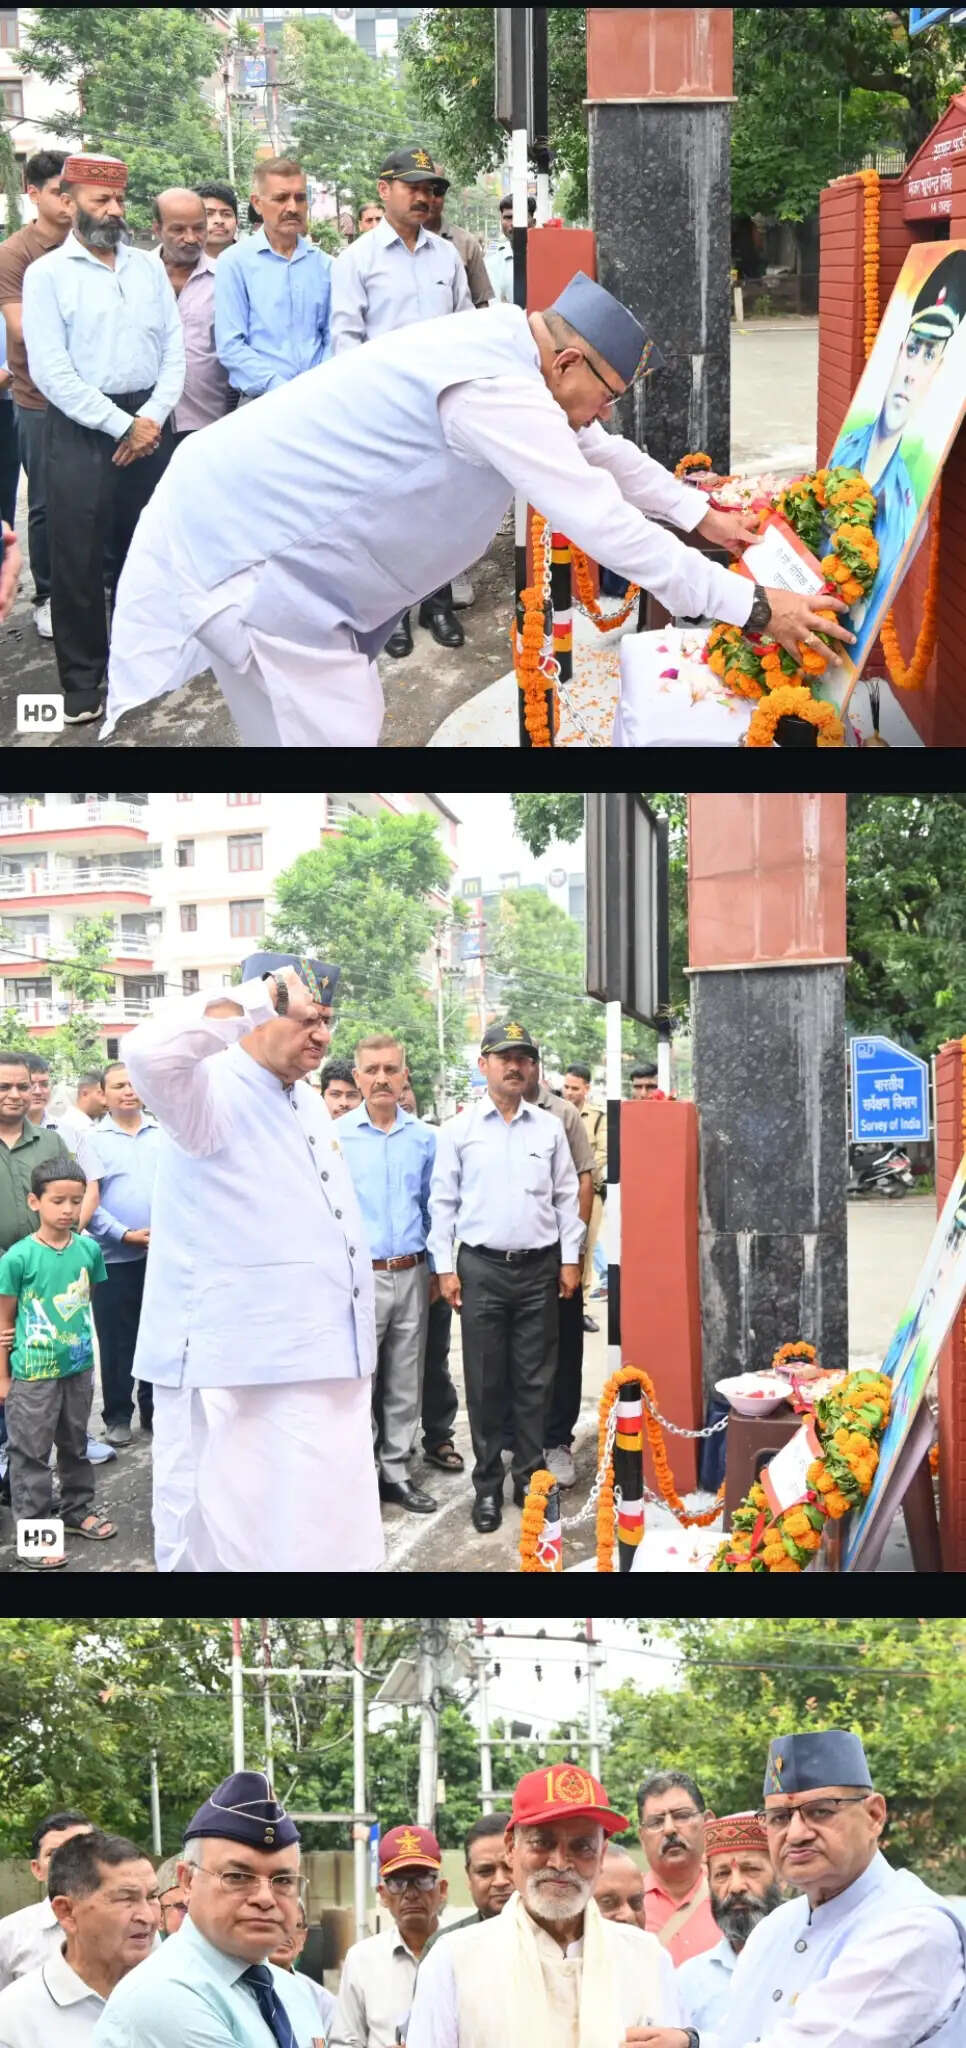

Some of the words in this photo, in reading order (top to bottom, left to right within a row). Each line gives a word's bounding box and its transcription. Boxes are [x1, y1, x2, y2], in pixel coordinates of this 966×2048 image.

[861, 1119, 888, 1133] Survey
[889, 1118, 899, 1130] of
[900, 1117, 921, 1130] India
